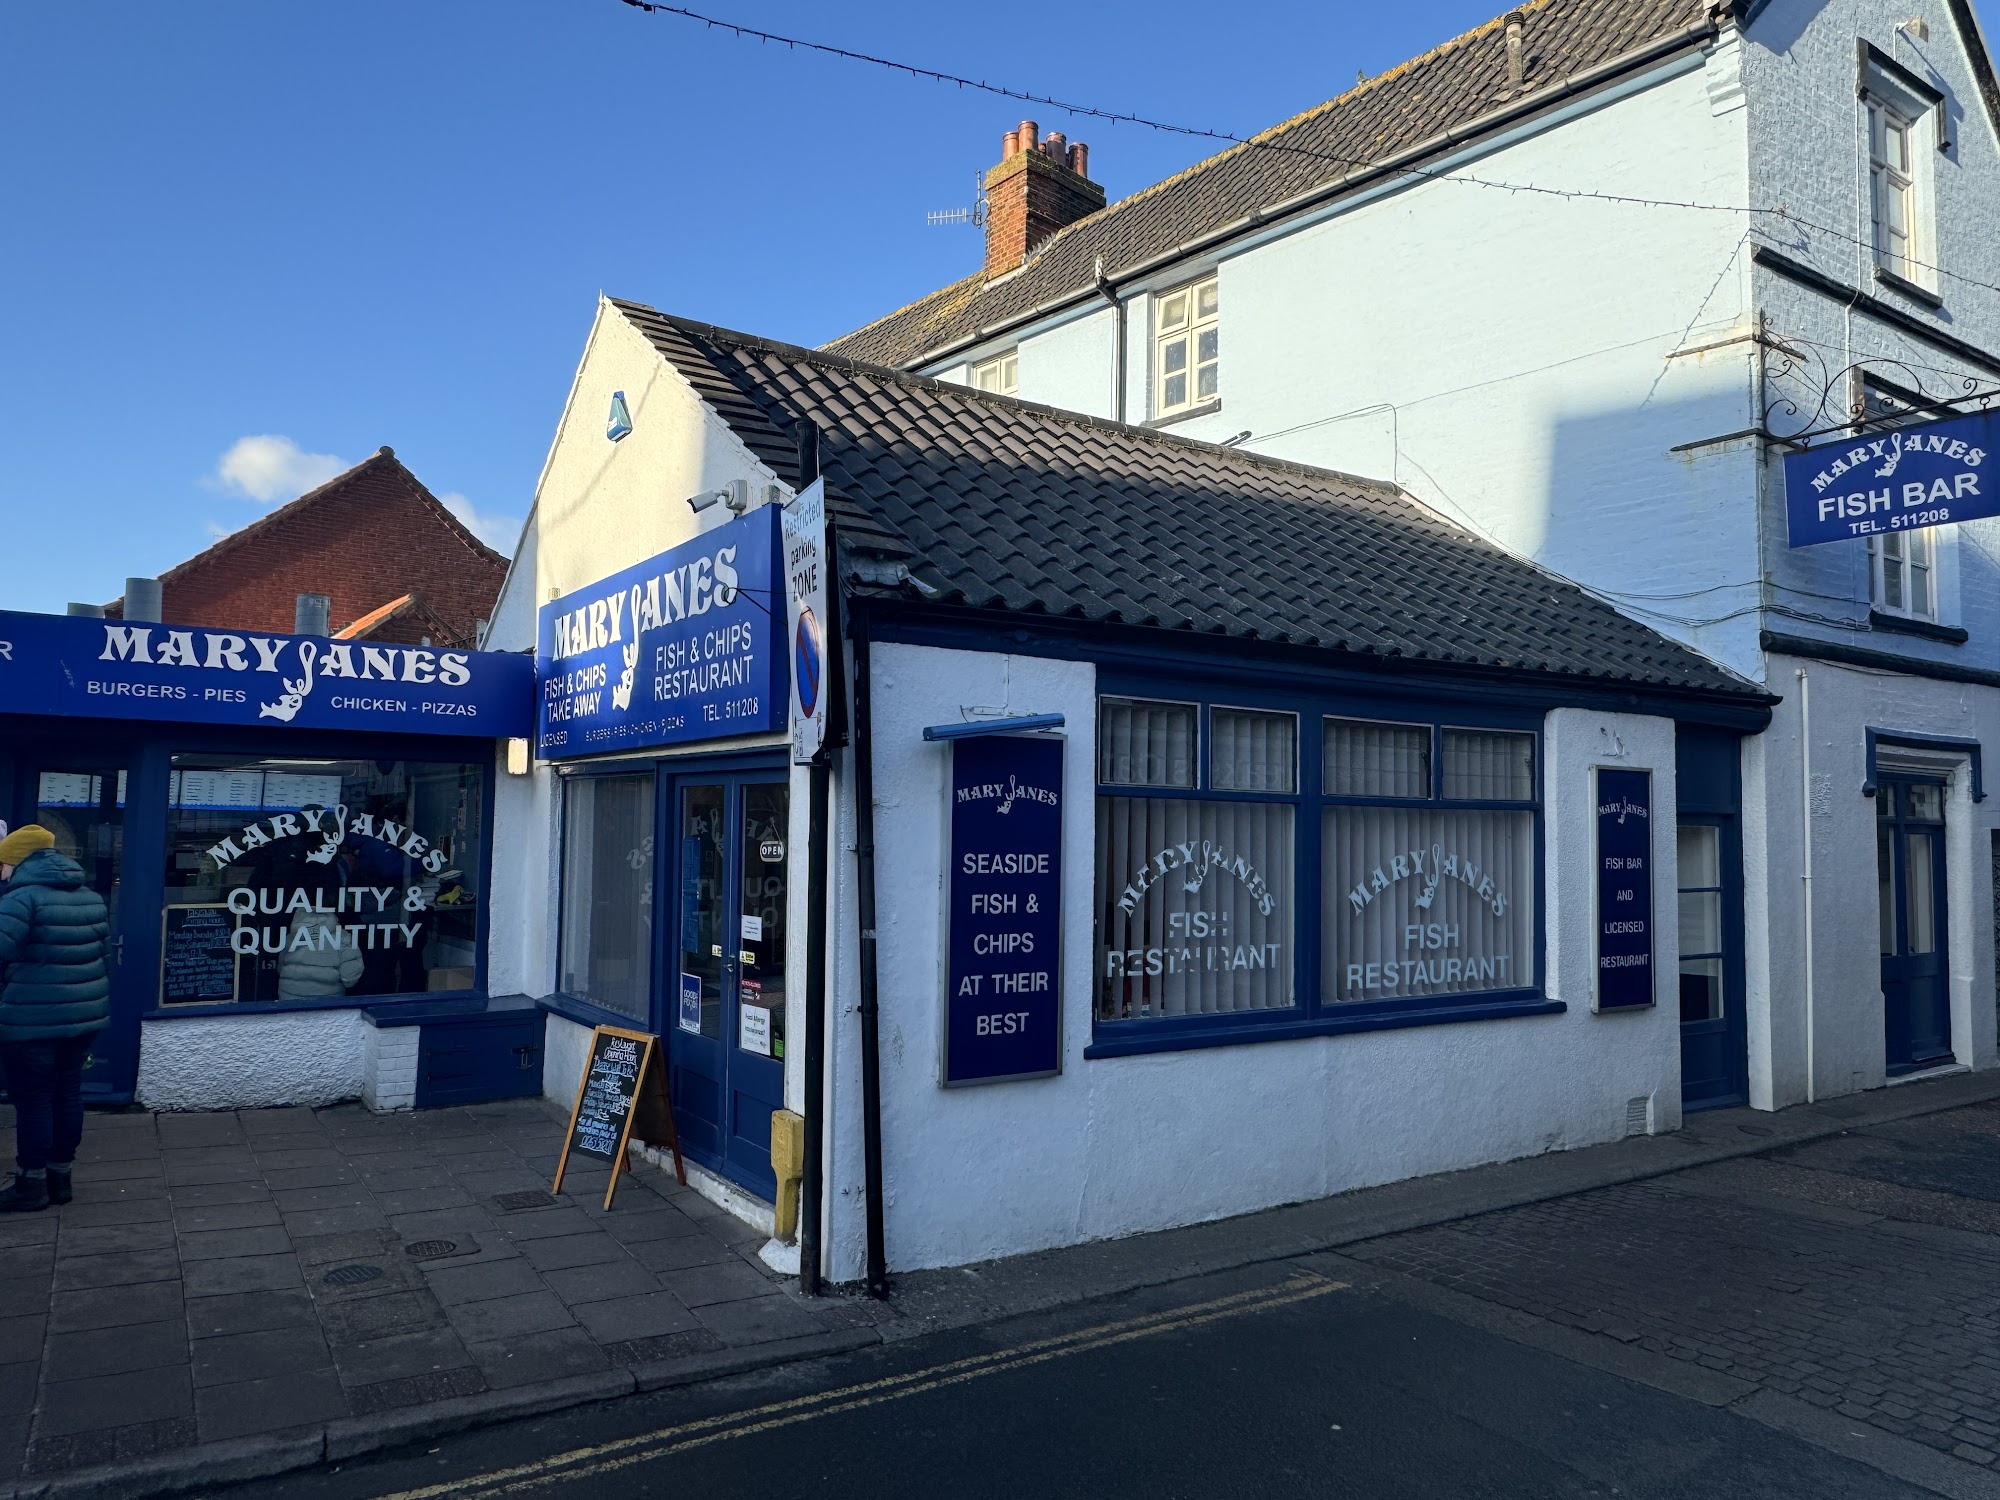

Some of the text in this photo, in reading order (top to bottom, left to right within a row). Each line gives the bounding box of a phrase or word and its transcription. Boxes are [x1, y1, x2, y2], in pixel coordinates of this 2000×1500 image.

[1810, 432, 1987, 494] MARY JANES
[1818, 472, 1981, 522] FISH BAR
[1849, 508, 1949, 535] TEL. 511208
[791, 536, 817, 571] parking
[792, 563, 818, 603] ZONE
[552, 544, 739, 669] MARY JANES
[656, 622, 752, 672] FISH & CHIPS
[98, 625, 472, 699] MARY JANES
[87, 681, 187, 700] BURGERS
[204, 687, 247, 703] PIES
[544, 663, 607, 700] FISH & CHIPS
[654, 655, 754, 702] RESTAURANT
[330, 696, 407, 712] CHICKEN
[422, 702, 477, 717] PIZZAS
[547, 691, 602, 723] TAKE AWAY
[703, 697, 759, 722] TEL. 511208
[957, 774, 1058, 806] MARY JANES
[1598, 802, 1621, 817] MARY
[206, 803, 449, 873] MARY JANES
[761, 845, 784, 856] OPEN
[962, 854, 1049, 875] SEASIDE
[1606, 857, 1643, 870] FISH BAR
[1348, 843, 1508, 917] MARY JANES
[227, 886, 427, 917] QUALITY &
[971, 893, 1039, 914] FISH &
[1616, 889, 1634, 901] AND
[1169, 911, 1228, 938] FISH
[1404, 923, 1459, 950] FISH
[1604, 920, 1645, 934] LICENSED
[230, 922, 422, 956] QUANTITY
[973, 932, 1035, 955] CHIPS
[1346, 955, 1509, 990] RESTAURANT
[1600, 953, 1649, 969] RESTAURANT
[958, 971, 1048, 996] AT THEIR
[976, 1012, 1029, 1036] BEST
